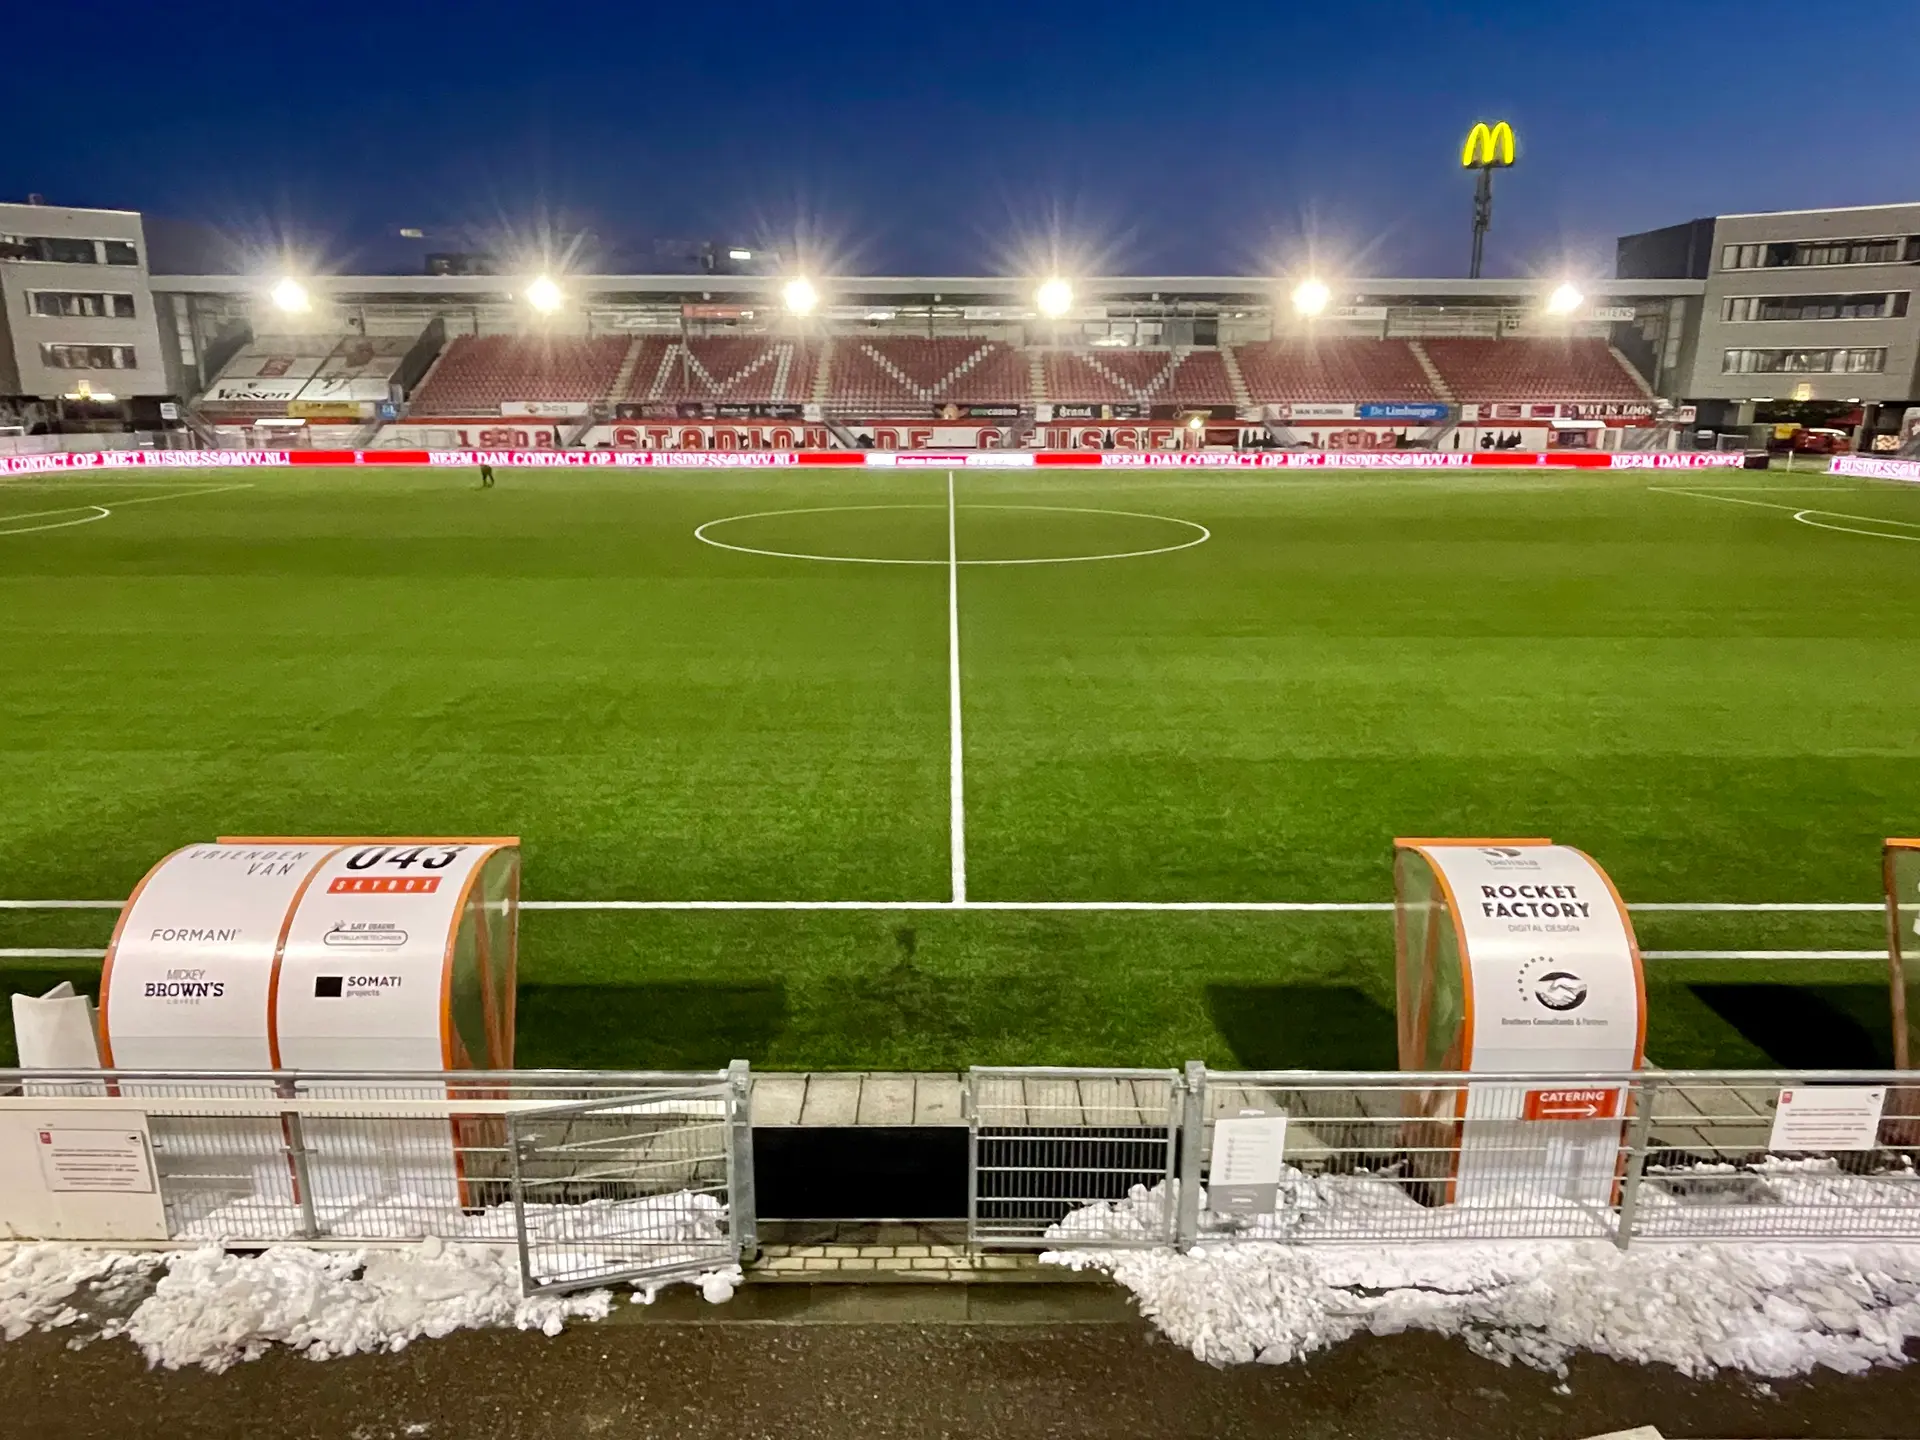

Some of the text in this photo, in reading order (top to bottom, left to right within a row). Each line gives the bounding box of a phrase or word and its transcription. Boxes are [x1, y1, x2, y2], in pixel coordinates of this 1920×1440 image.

[1370, 405, 1437, 417] De Limburger
[1578, 404, 1652, 415] WAT IS LOOS
[613, 427, 829, 450] STADION
[874, 428, 933, 450] DE
[11, 456, 68, 472] CONTACT
[72, 453, 98, 468] OP
[102, 452, 141, 466] MET
[430, 453, 473, 465] NEEM
[477, 453, 509, 465] DAN
[513, 453, 585, 465] CONTACT
[590, 453, 610, 465] OP
[615, 453, 648, 465] MET
[1101, 454, 1146, 466] NEEM
[1151, 454, 1182, 466] DAN
[1186, 454, 1258, 467] CONTACT
[1261, 454, 1284, 466] OP
[1288, 454, 1320, 467] MET
[1611, 455, 1655, 467] NEEM
[1658, 455, 1690, 467] DAN
[189, 850, 309, 860] VRIENDEN
[346, 846, 468, 870] 043
[246, 863, 295, 875] VAN
[1481, 885, 1578, 899] ROCKET
[1482, 902, 1590, 918] FACTORY
[1508, 924, 1580, 932] DIGITAL DESIGN
[151, 928, 237, 942] FORMANI
[166, 969, 206, 980] MICKEY
[347, 976, 402, 987] SOMATI
[144, 982, 224, 997] BROWN'S
[346, 988, 380, 998] projects
[1501, 1017, 1532, 1026] Brothers
[1533, 1017, 1574, 1026] Consultants
[1540, 1091, 1605, 1102] CATERING
